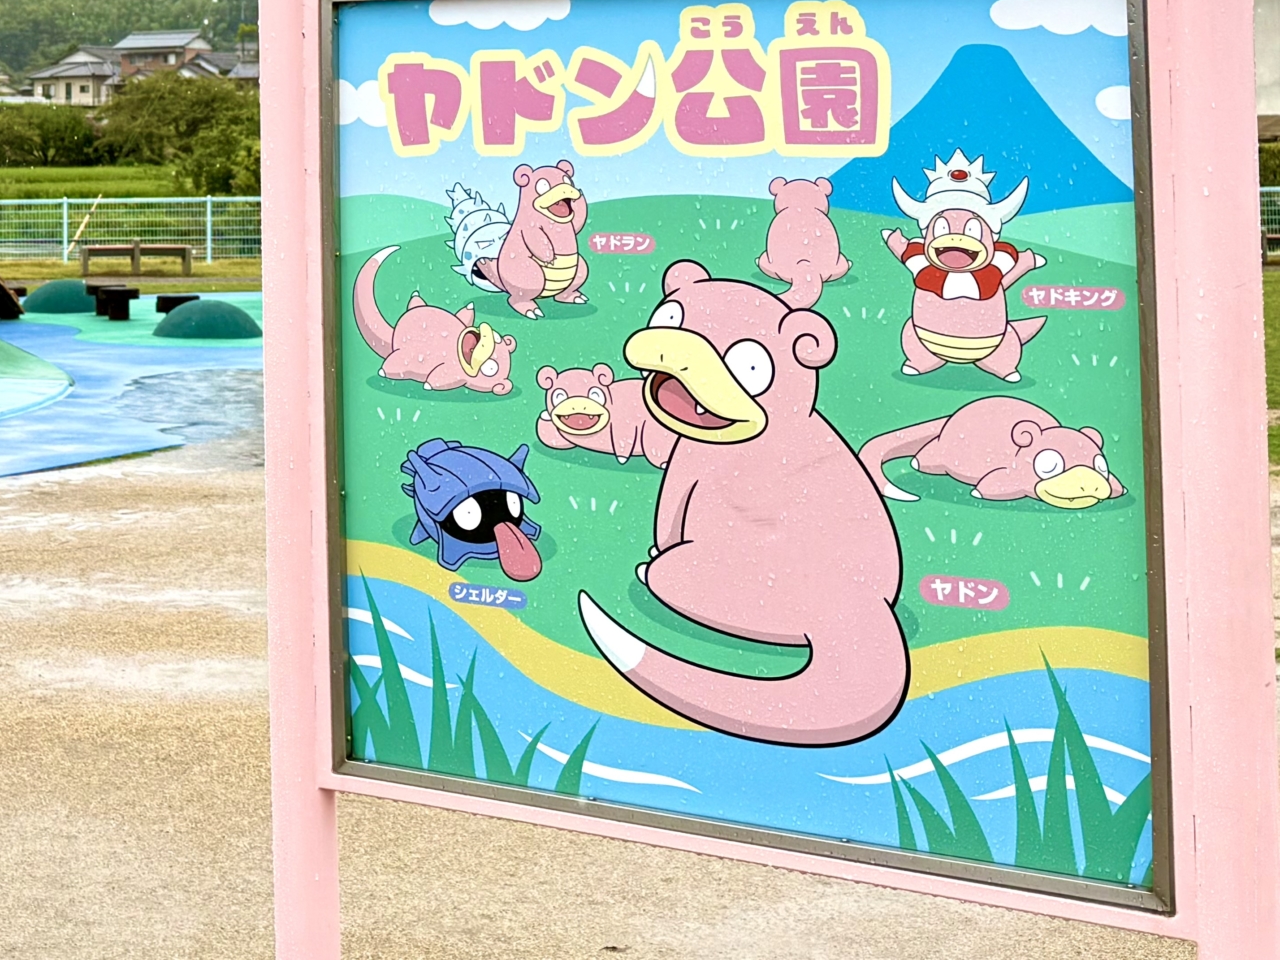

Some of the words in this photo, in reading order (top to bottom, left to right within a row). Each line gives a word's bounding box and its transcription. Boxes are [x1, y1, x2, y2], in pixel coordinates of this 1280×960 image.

[690, 16, 744, 39] こう
[796, 11, 854, 37] えん
[387, 46, 879, 147] ヤドン公園
[593, 234, 651, 251] ヤドラン
[1028, 287, 1118, 307] ヤドキング
[454, 584, 522, 605] シェルダー
[930, 578, 999, 605] ヤドン
